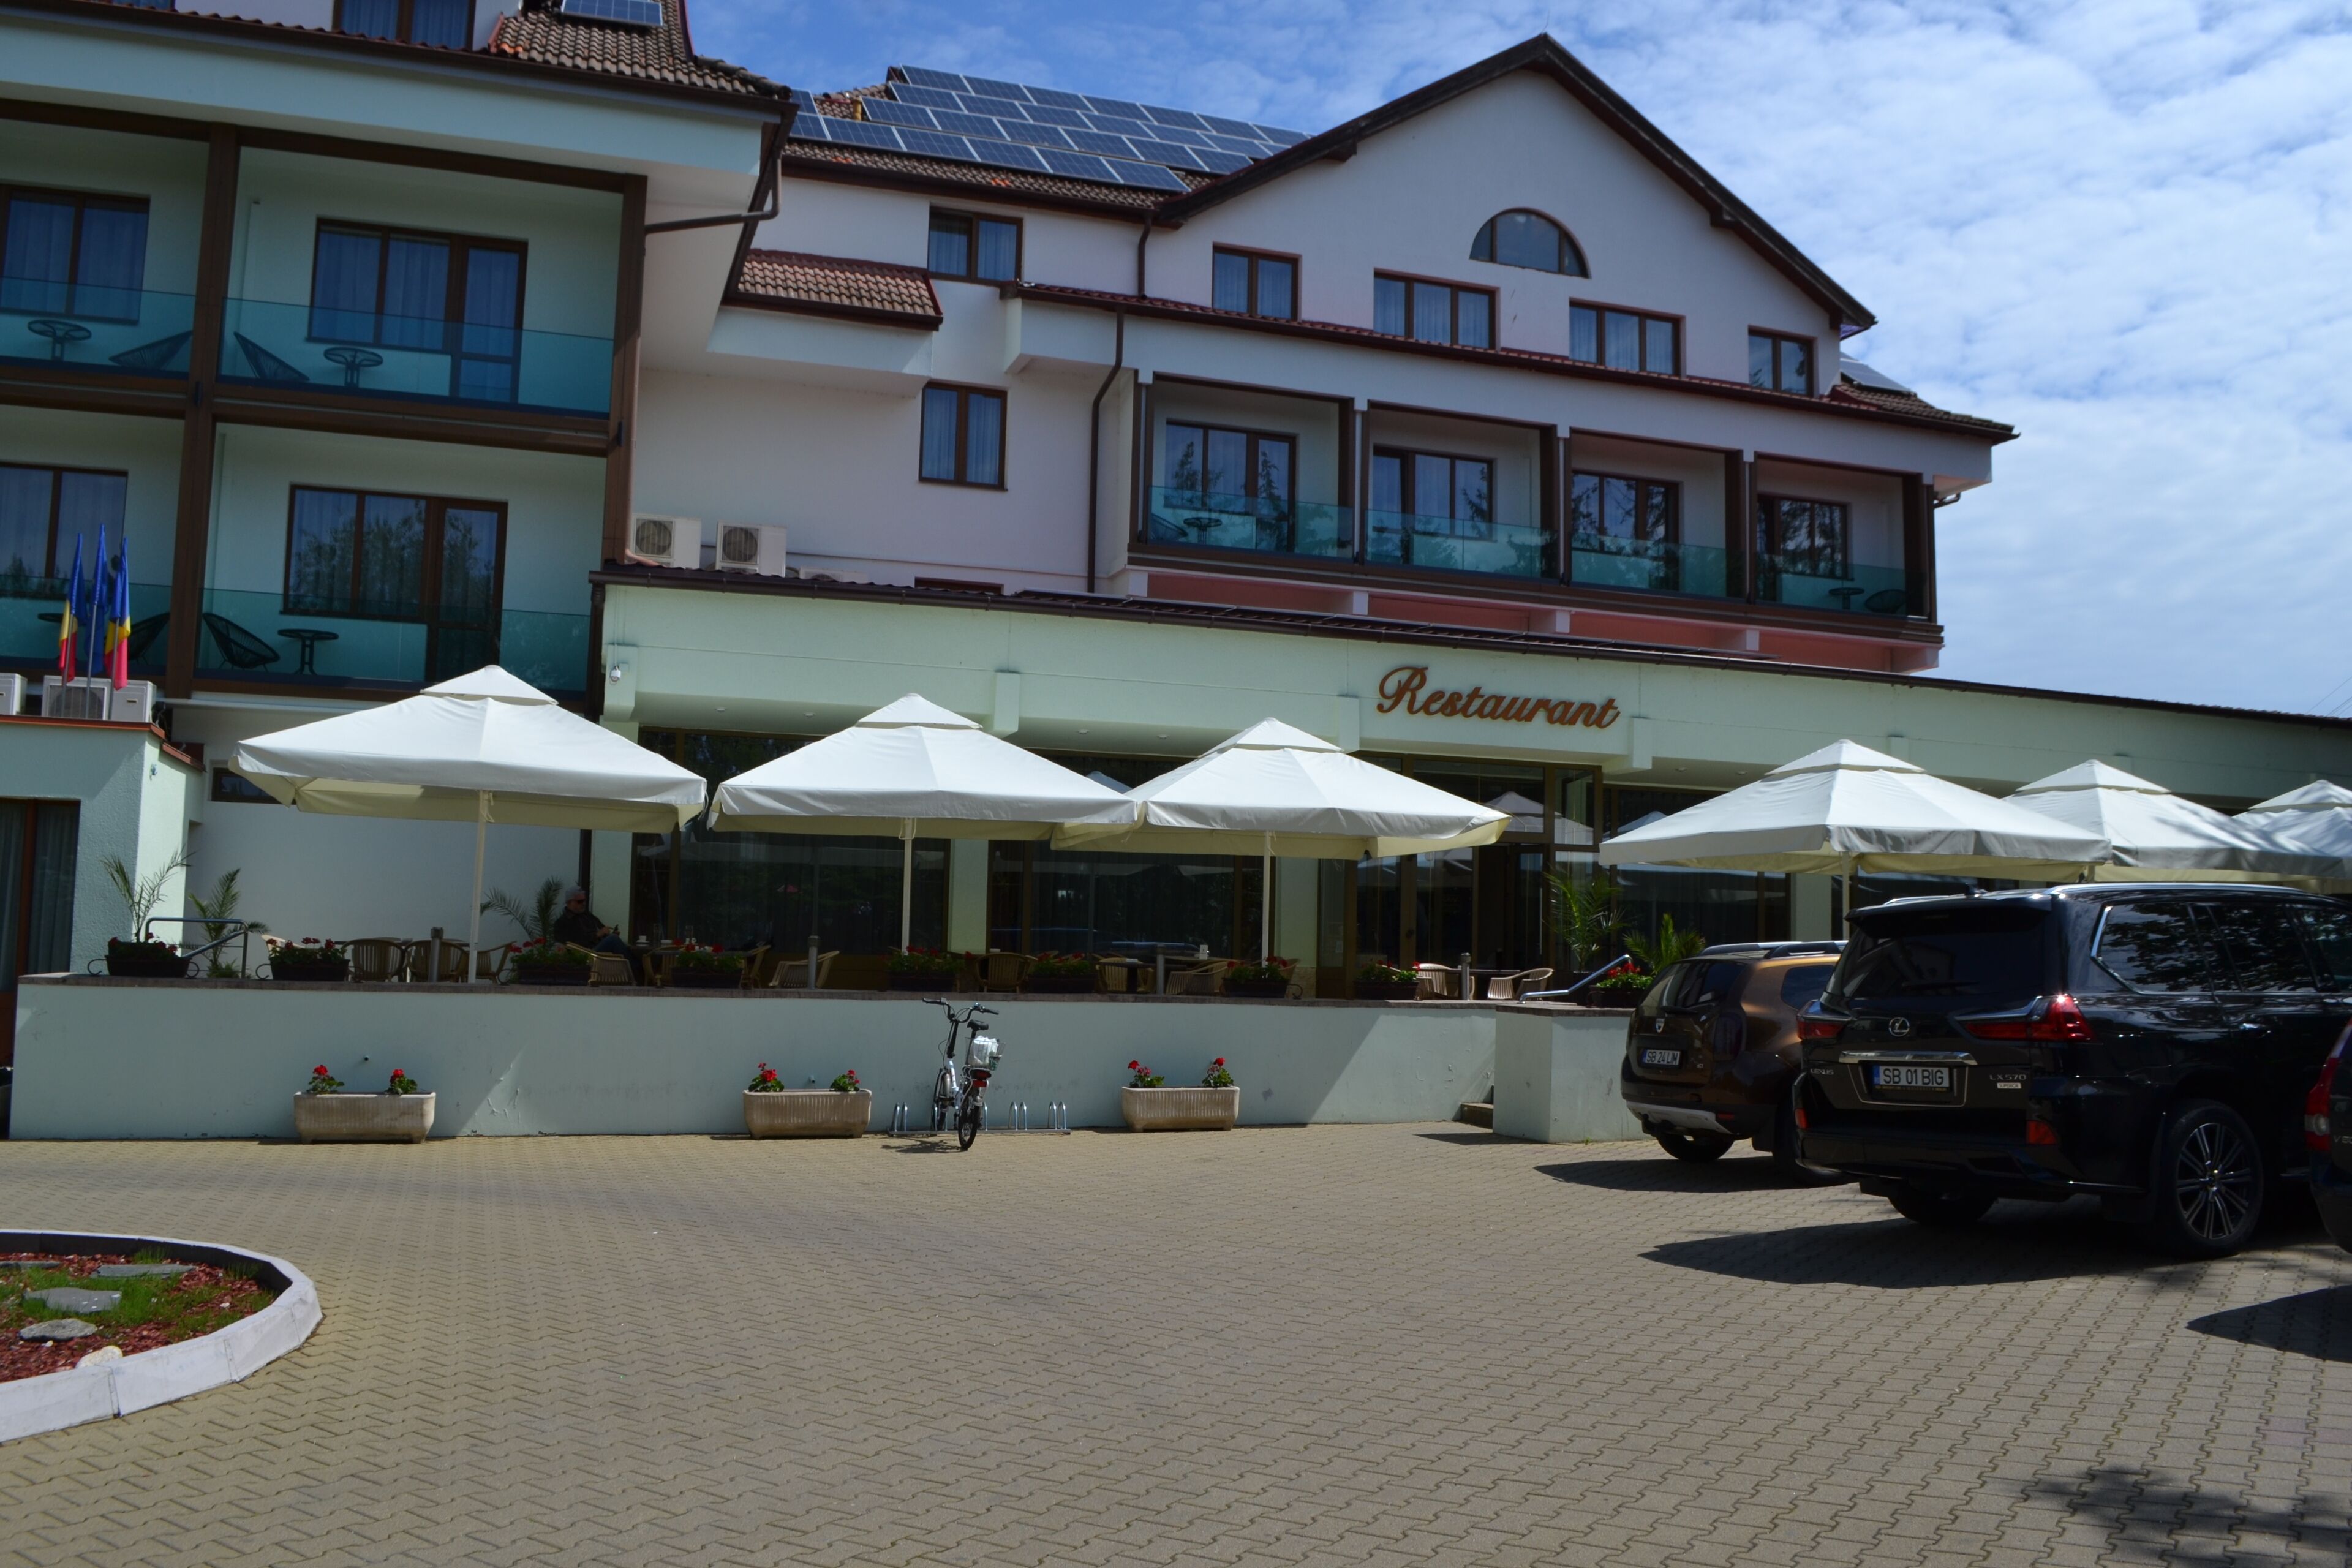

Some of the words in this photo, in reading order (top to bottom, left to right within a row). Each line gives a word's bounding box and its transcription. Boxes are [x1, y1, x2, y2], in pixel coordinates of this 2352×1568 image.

[1376, 666, 1621, 729] Restaurant
[1646, 1051, 1657, 1063] SB
[1657, 1052, 1666, 1063] 24
[1666, 1052, 1678, 1065] LIM
[1883, 1068, 1901, 1084] SB
[1905, 1068, 1918, 1085] 01
[1921, 1069, 1944, 1085] BIG
